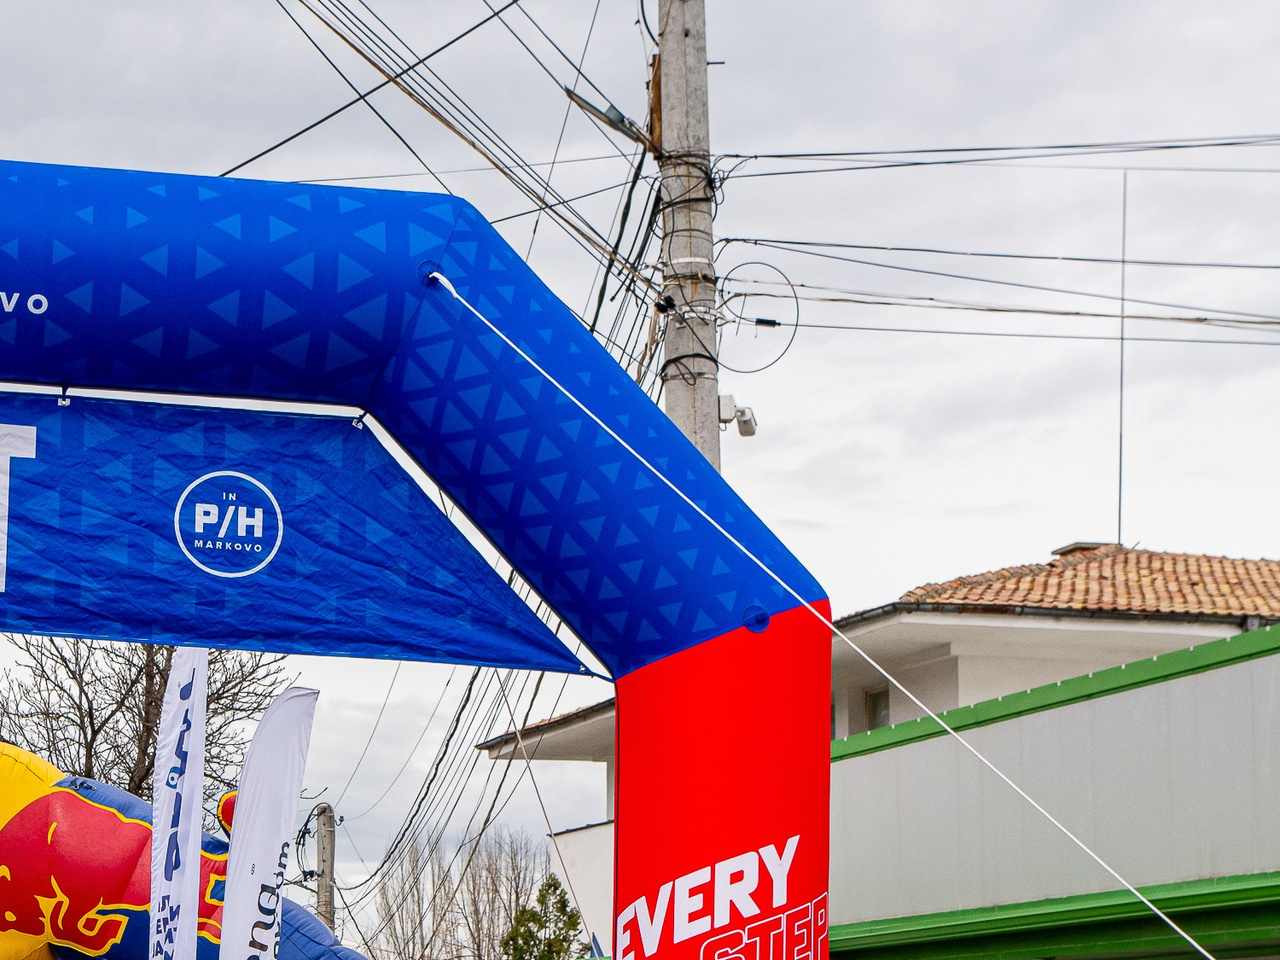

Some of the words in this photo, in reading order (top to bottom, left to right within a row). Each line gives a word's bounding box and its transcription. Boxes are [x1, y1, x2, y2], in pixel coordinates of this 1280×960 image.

[222, 492, 237, 501] IN
[194, 503, 264, 538] P/H
[194, 539, 262, 553] MARKOVO
